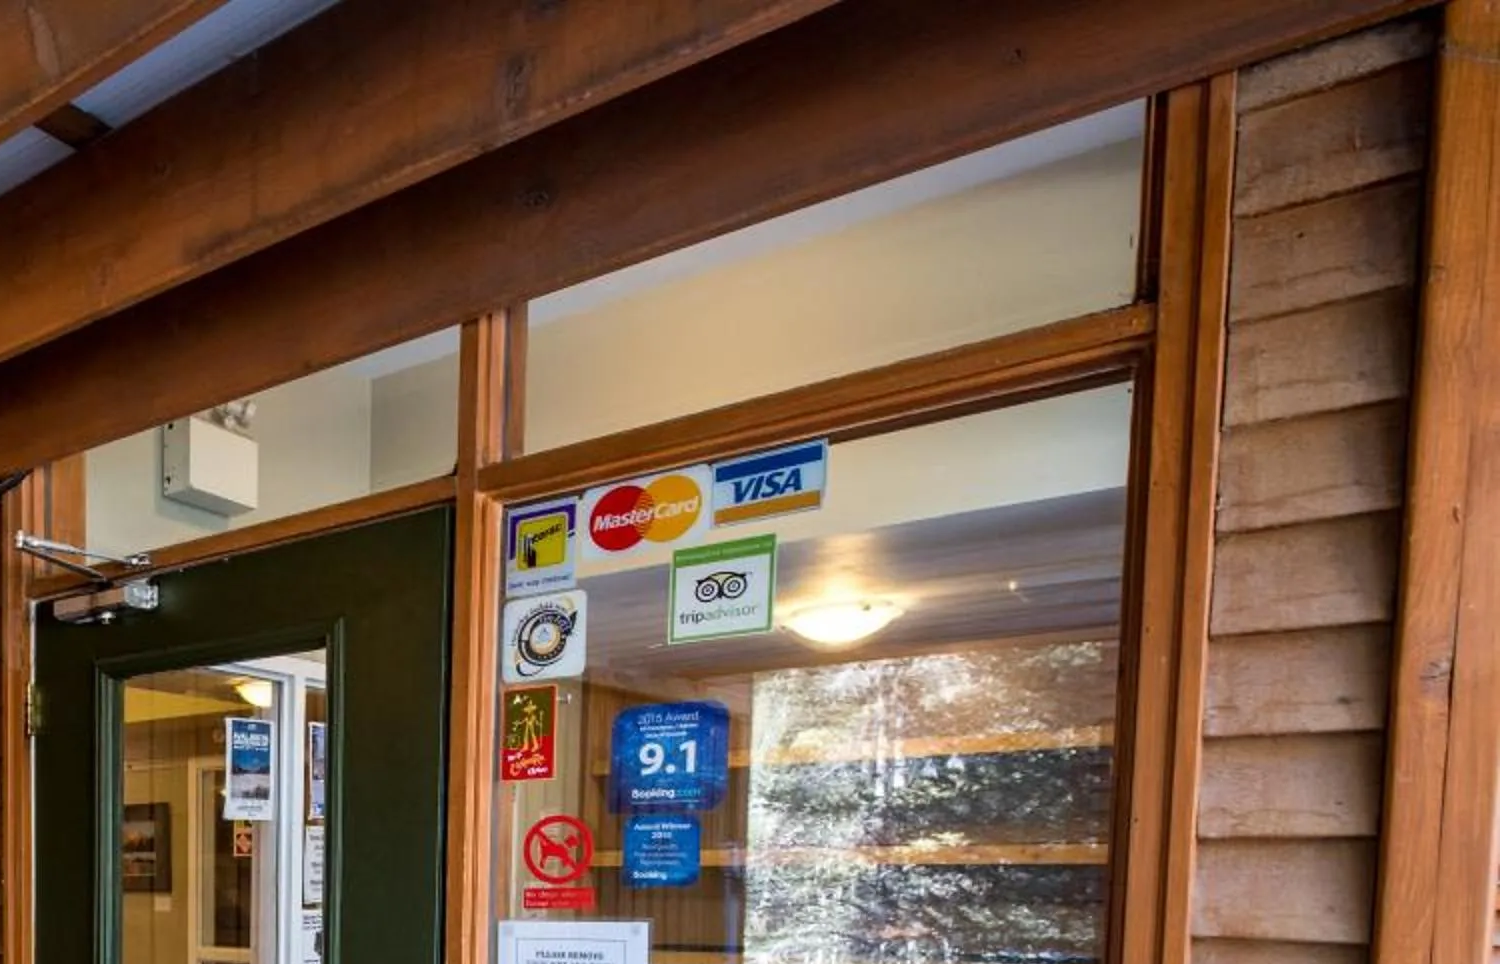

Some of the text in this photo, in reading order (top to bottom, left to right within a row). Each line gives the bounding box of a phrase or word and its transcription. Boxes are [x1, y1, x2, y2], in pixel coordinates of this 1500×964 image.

[732, 469, 802, 504] VISA
[592, 496, 699, 532] MasterCard
[679, 605, 759, 625] tripadvisor
[664, 711, 699, 722] Award
[639, 740, 697, 776] 9.1
